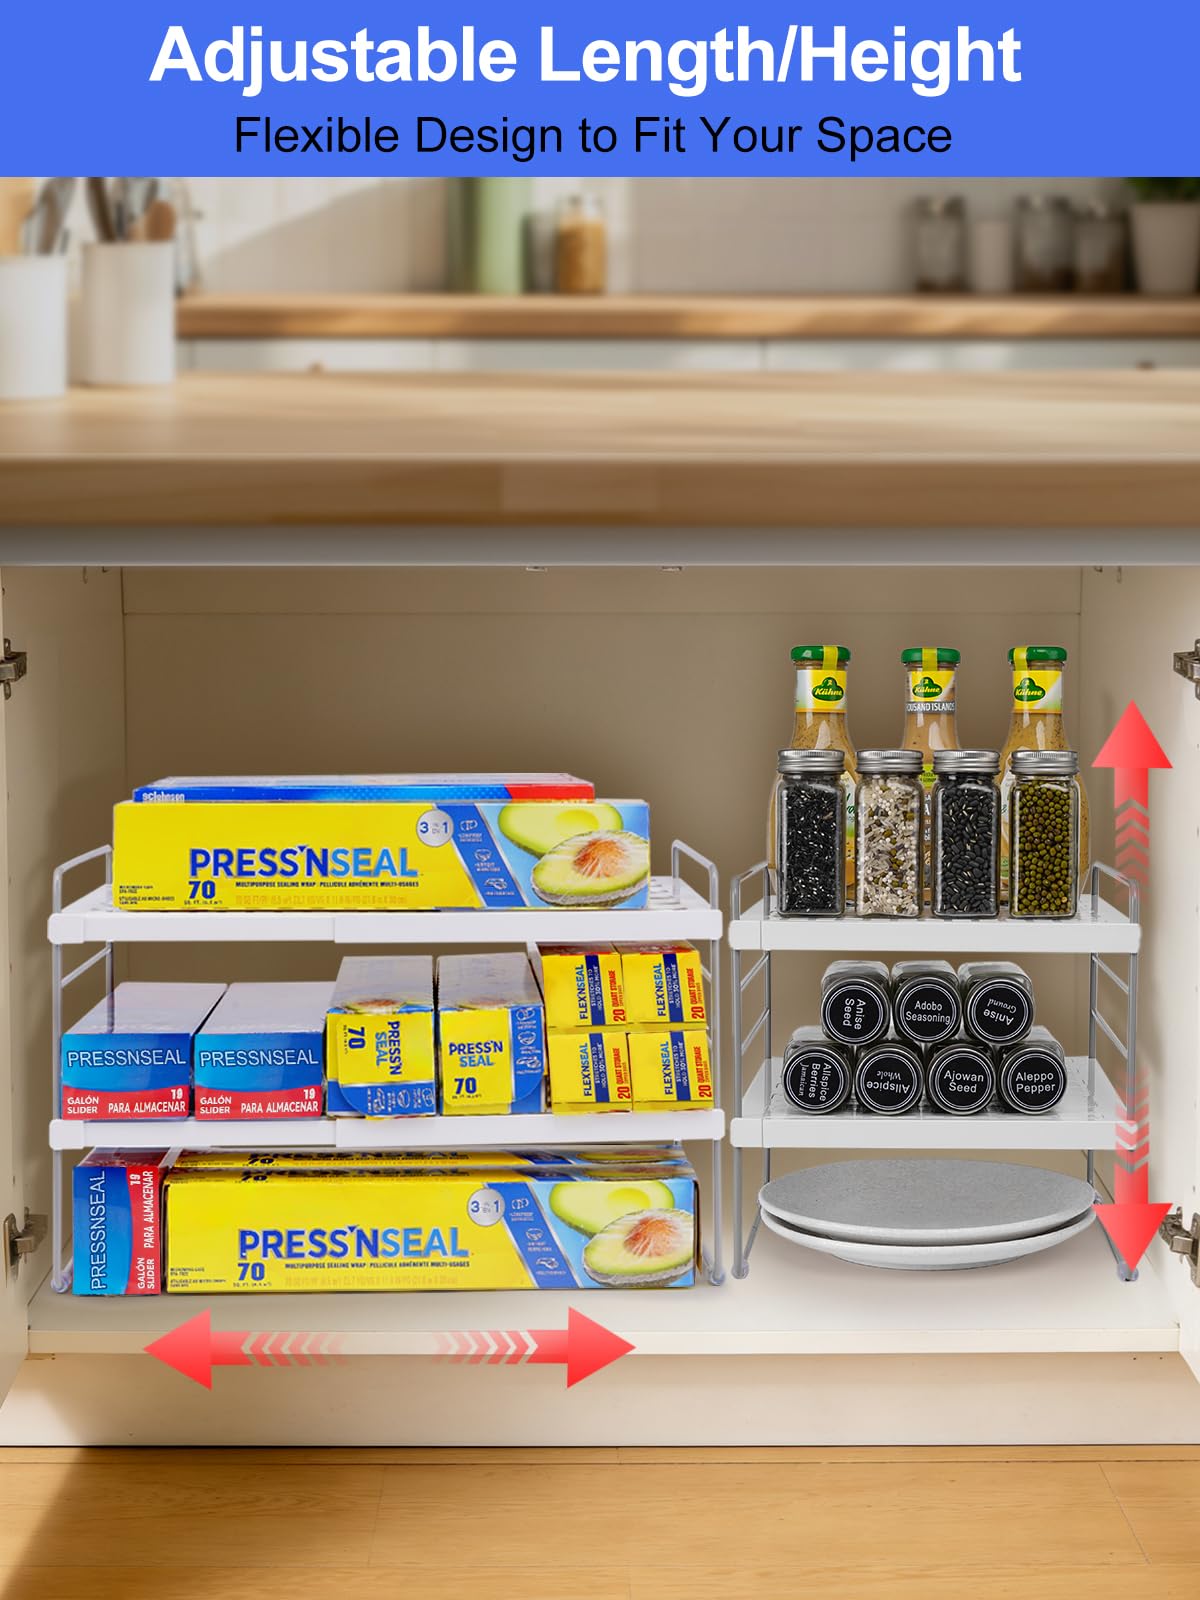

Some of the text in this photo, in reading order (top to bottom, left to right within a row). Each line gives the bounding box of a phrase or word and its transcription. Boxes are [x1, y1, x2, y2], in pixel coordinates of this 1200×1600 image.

[815, 687, 842, 696] Kühne
[1015, 688, 1042, 696] Kühne
[420, 821, 448, 834] 3 1
[188, 880, 216, 899] 70
[691, 1006, 704, 1019] 20
[842, 998, 855, 1027] Seed
[914, 1000, 942, 1012] Adobo
[987, 998, 1017, 1014] Ground
[613, 1009, 625, 1022] 20
[854, 998, 866, 1030] Anise
[905, 1012, 950, 1025] Seasoning
[983, 1008, 1014, 1026] Anise
[348, 1027, 366, 1049] 70
[375, 1032, 388, 1067] SEAL
[67, 1049, 186, 1067] PRESSNSEAL
[200, 1049, 319, 1067] PRESSNSEAL
[459, 1055, 494, 1067] SEAL
[808, 1063, 821, 1099] Berries
[819, 1062, 832, 1102] Allspice
[876, 1070, 901, 1081] Whole
[943, 1070, 984, 1082] Ajowan
[1015, 1072, 1054, 1083] Aleppo
[454, 1077, 477, 1095] 70
[617, 1086, 631, 1099] 20
[698, 1085, 712, 1098] 20
[866, 1081, 910, 1094] Allspice
[948, 1081, 977, 1093] Seed
[1016, 1083, 1056, 1095] Pepper
[67, 1095, 99, 1105] GALÓN
[200, 1095, 232, 1105] GALÓN
[304, 1088, 316, 1100] 19
[67, 1106, 98, 1114] SLIDER
[108, 1101, 186, 1113] PARA ALMACENAR
[200, 1106, 230, 1114] SLIDER
[241, 1101, 318, 1113] PARA ALMACENAR
[130, 1173, 141, 1186] 19
[142, 1171, 155, 1248] PARA ALMACENAR
[471, 1200, 499, 1213] 3 1
[90, 1170, 106, 1289] PRESSNSEAL
[136, 1257, 145, 1289] GALÓN
[147, 1258, 155, 1289] SLIDER
[237, 1262, 265, 1281] 70
